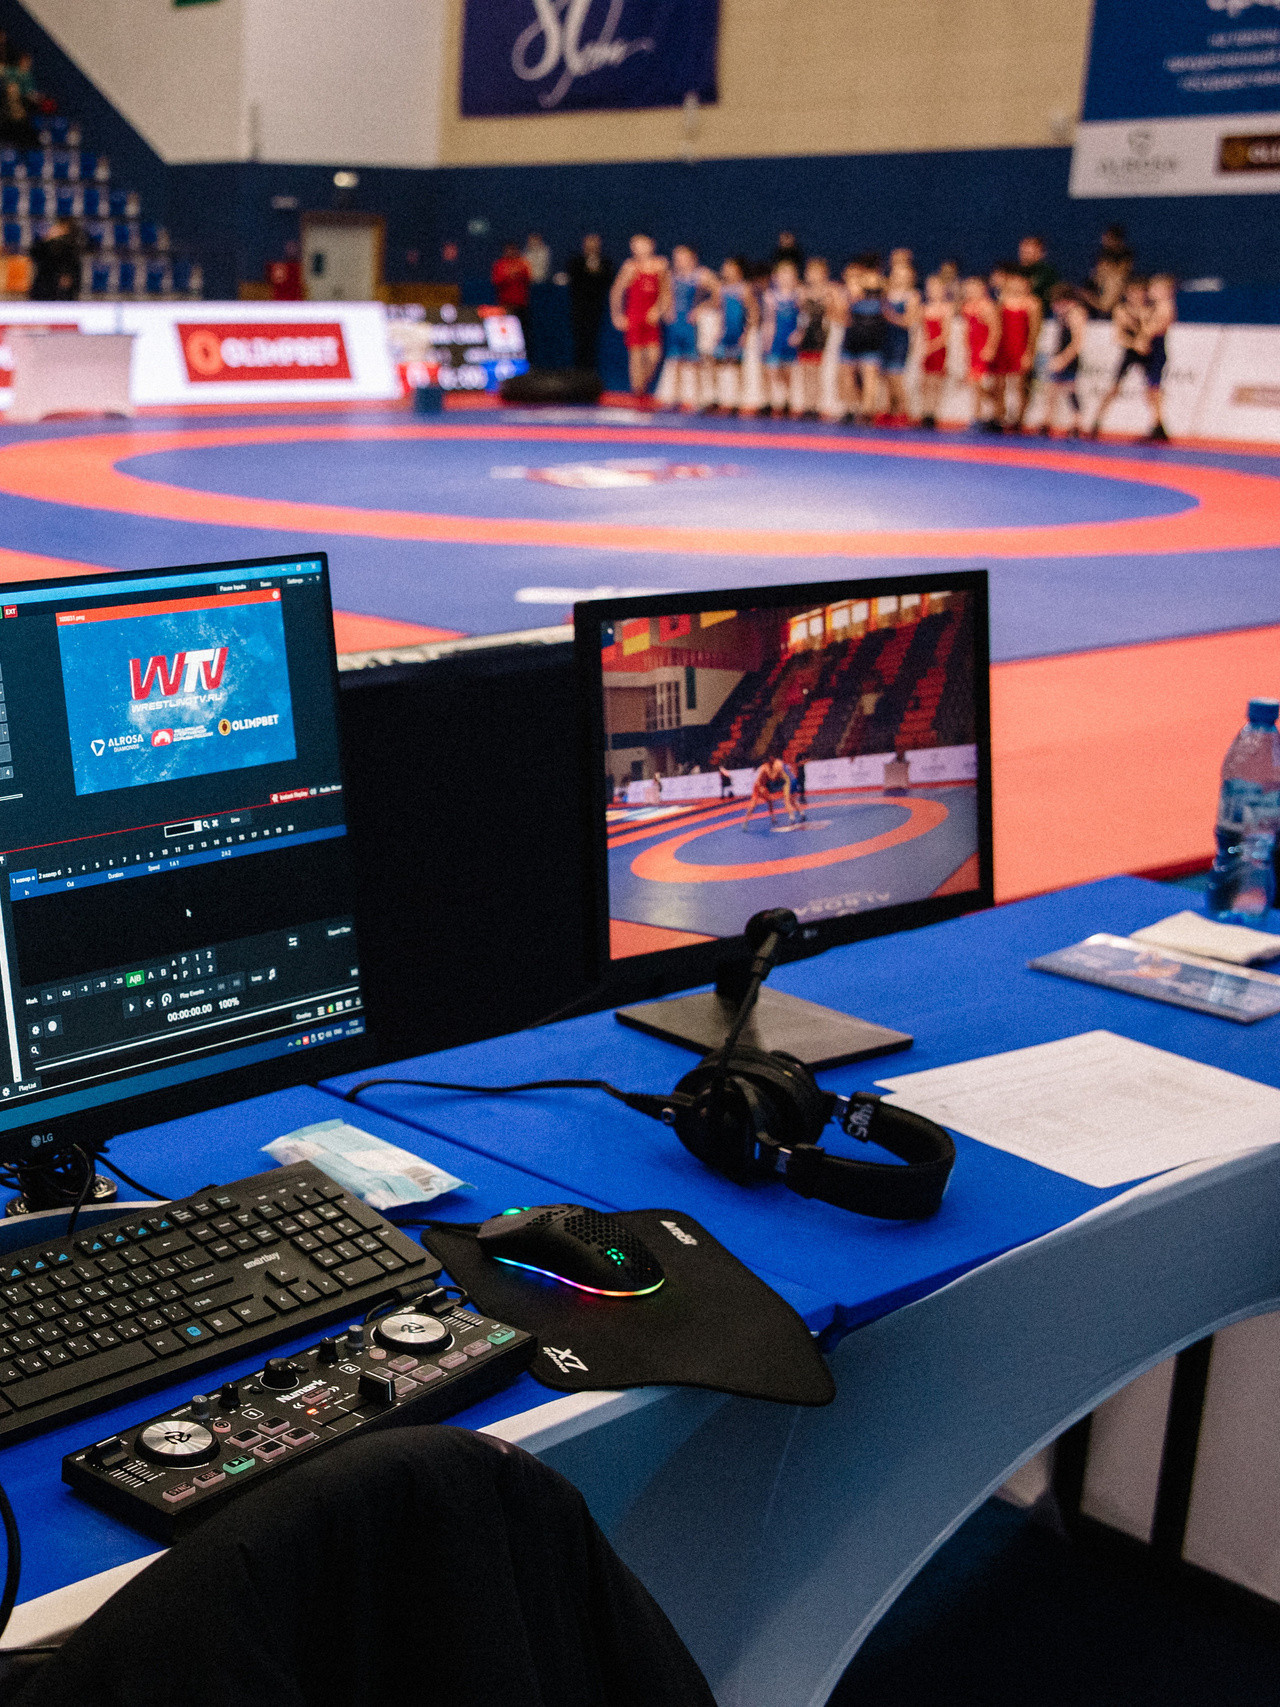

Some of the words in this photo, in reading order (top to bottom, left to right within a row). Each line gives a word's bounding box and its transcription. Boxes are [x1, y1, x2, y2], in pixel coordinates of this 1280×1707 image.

[5, 608, 16, 616] EXT
[232, 714, 280, 732] OLIMPBET
[108, 734, 144, 748] ALROSA
[167, 1004, 212, 1022] 00:00:00.00
[219, 997, 240, 1009] 100%
[19, 1083, 37, 1092] PlayList
[42, 1133, 54, 1144] LG
[243, 1252, 281, 1269] smartbuy
[550, 1346, 589, 1371] X7
[276, 1379, 327, 1403] Numark
[201, 1470, 219, 1480] CUE
[168, 1482, 191, 1496] SYNC
